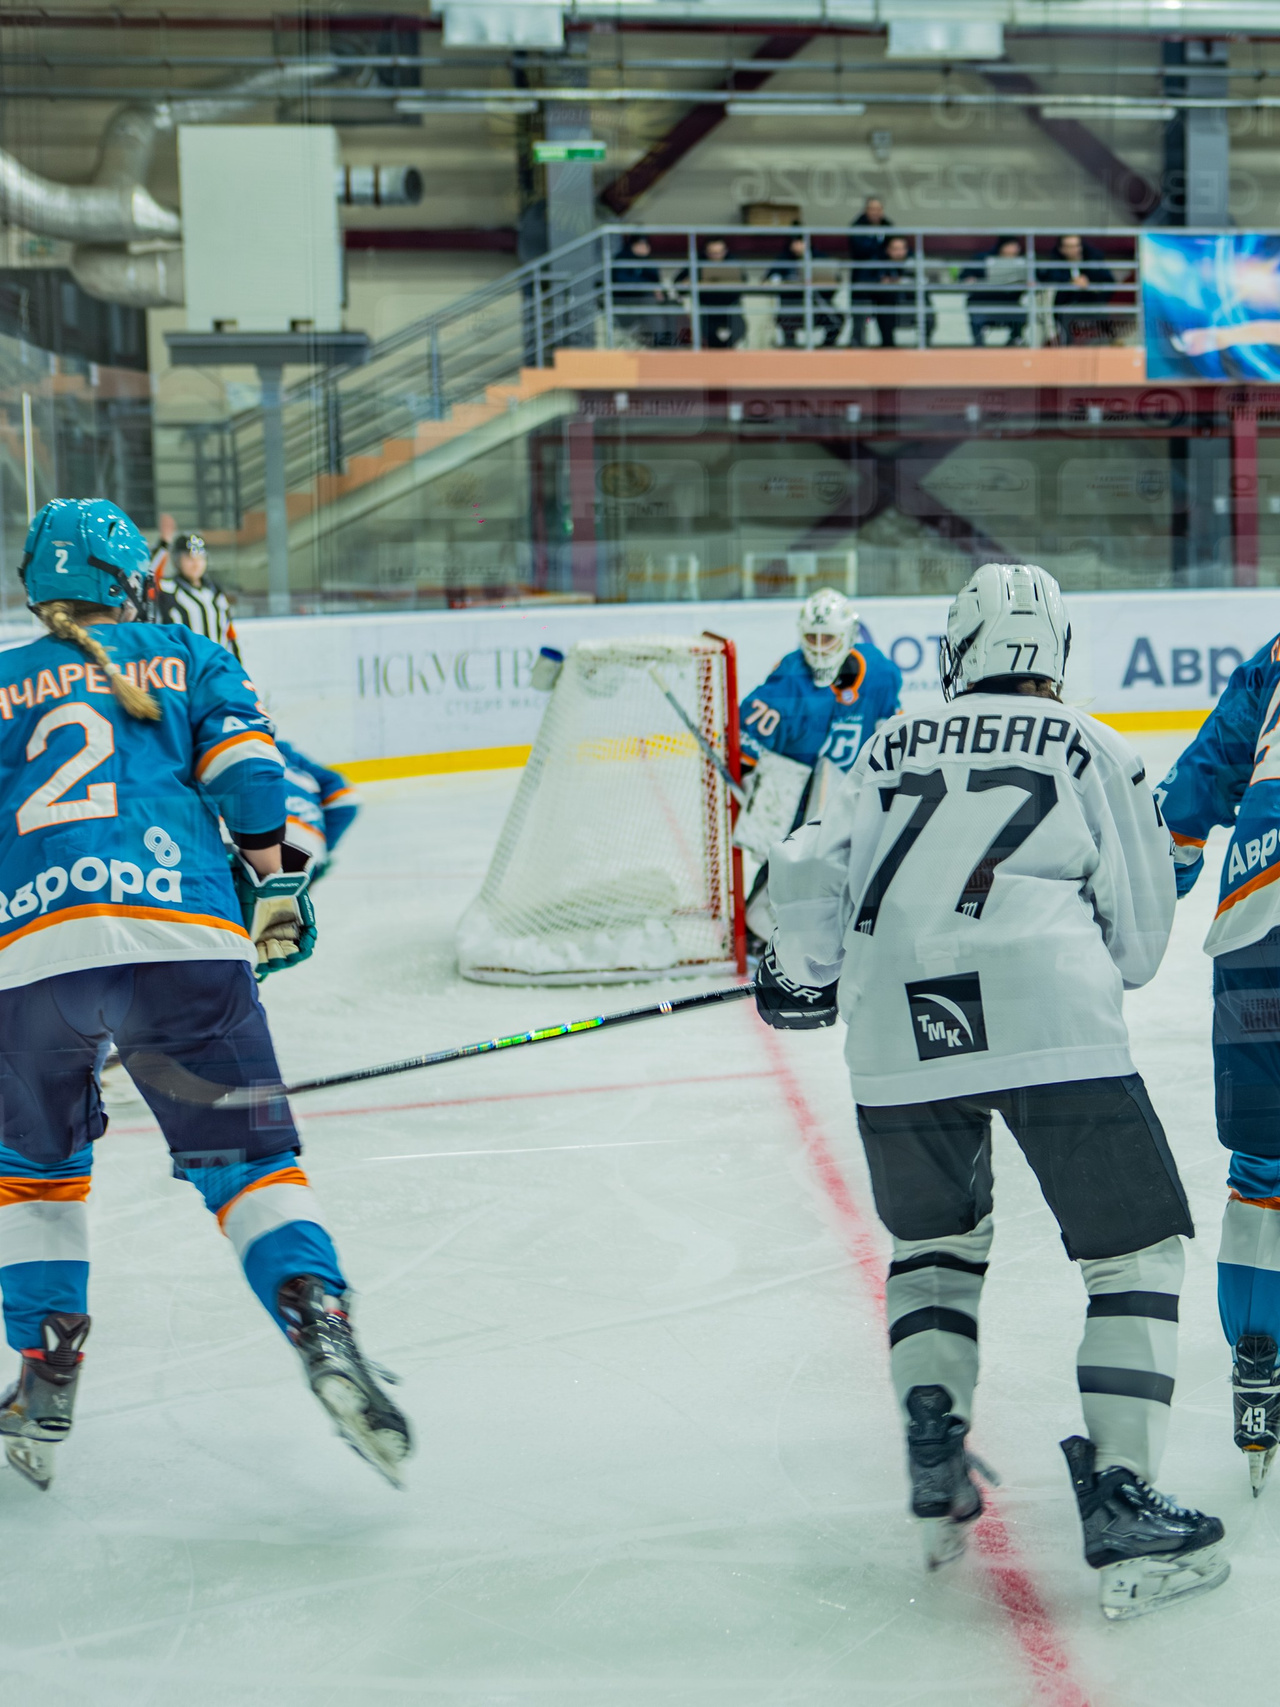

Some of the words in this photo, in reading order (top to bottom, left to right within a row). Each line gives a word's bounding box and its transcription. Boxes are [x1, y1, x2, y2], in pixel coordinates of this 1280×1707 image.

[55, 549, 69, 574] 2
[1006, 643, 1039, 672] 77
[1122, 637, 1244, 697] Авр
[744, 699, 780, 737] 70
[16, 702, 118, 836] 2
[854, 765, 1059, 936] 77
[917, 1014, 963, 1048] ТМК
[1240, 1406, 1267, 1433] 43
